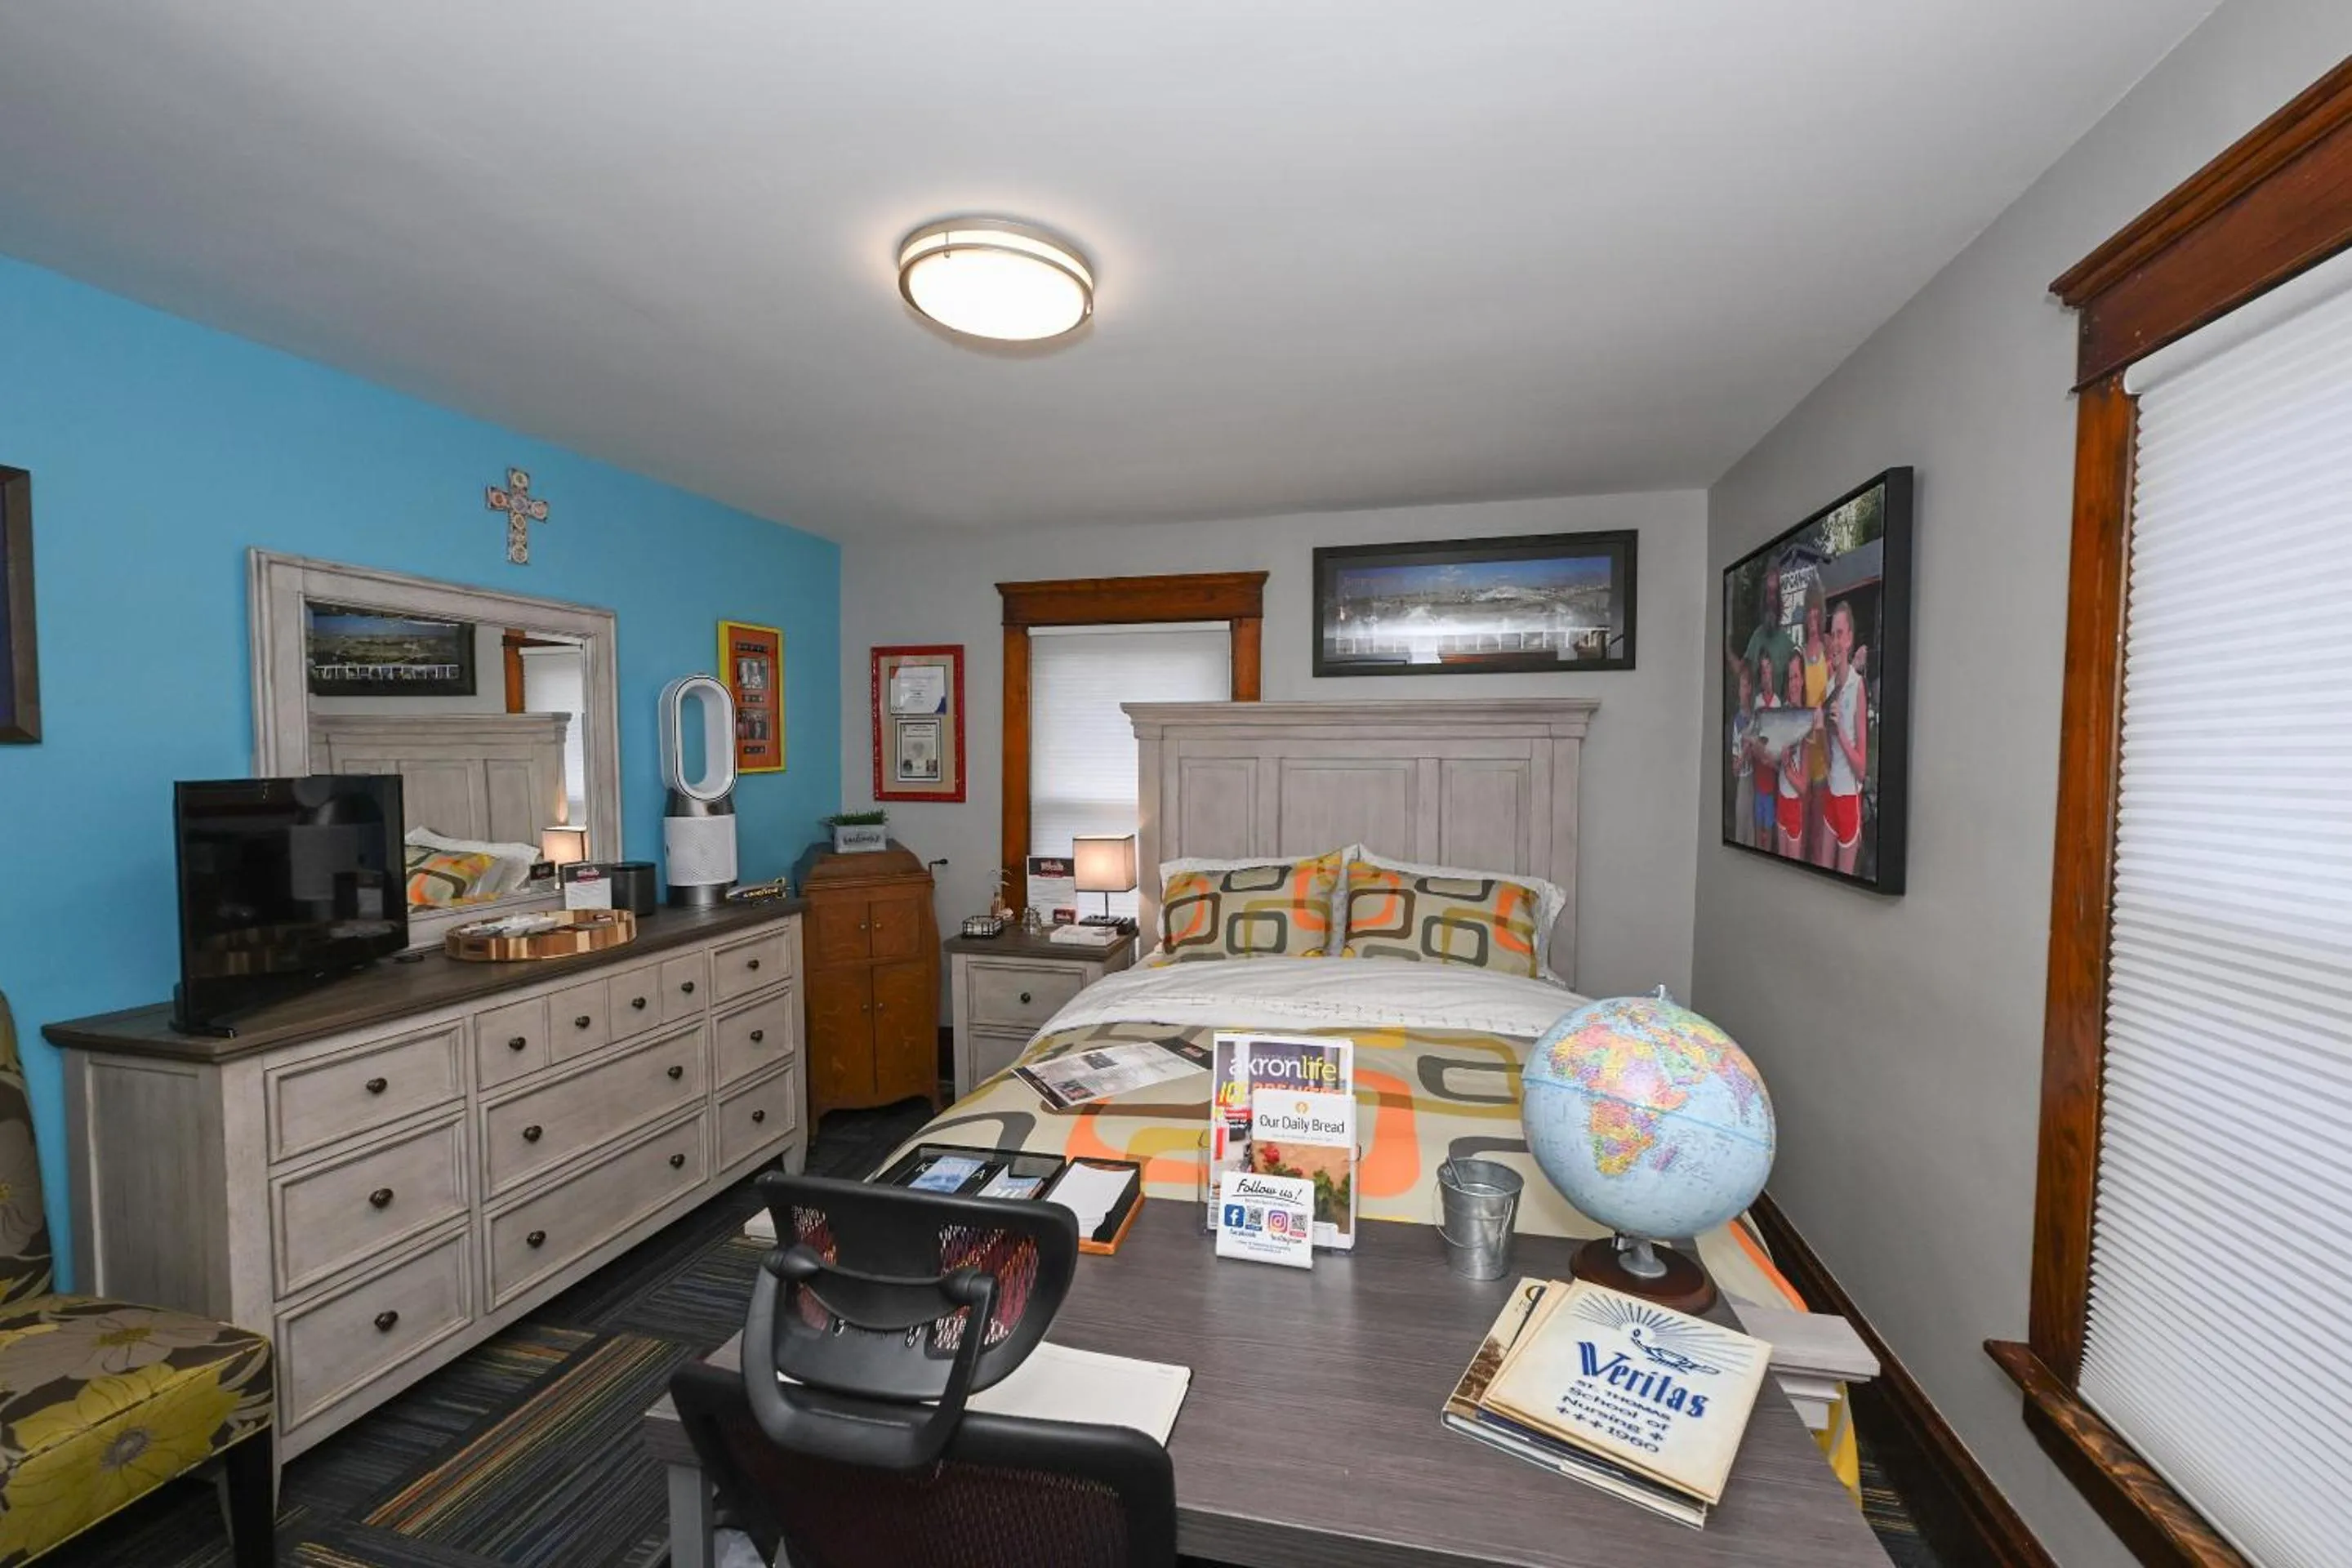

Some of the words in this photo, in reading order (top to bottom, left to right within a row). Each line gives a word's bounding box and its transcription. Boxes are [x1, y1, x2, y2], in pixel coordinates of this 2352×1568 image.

[1229, 1055, 1337, 1082] akronlife
[1259, 1114, 1280, 1129] Our
[1282, 1116, 1310, 1134] Daily
[1312, 1120, 1345, 1134] Bread
[1236, 1178, 1276, 1195] Follow
[1577, 1341, 1710, 1419] Veritas
[1561, 1395, 1642, 1434] Nursing
[1569, 1387, 1638, 1419] School
[1646, 1418, 1671, 1432] of
[1606, 1390, 1672, 1422] THOMAS
